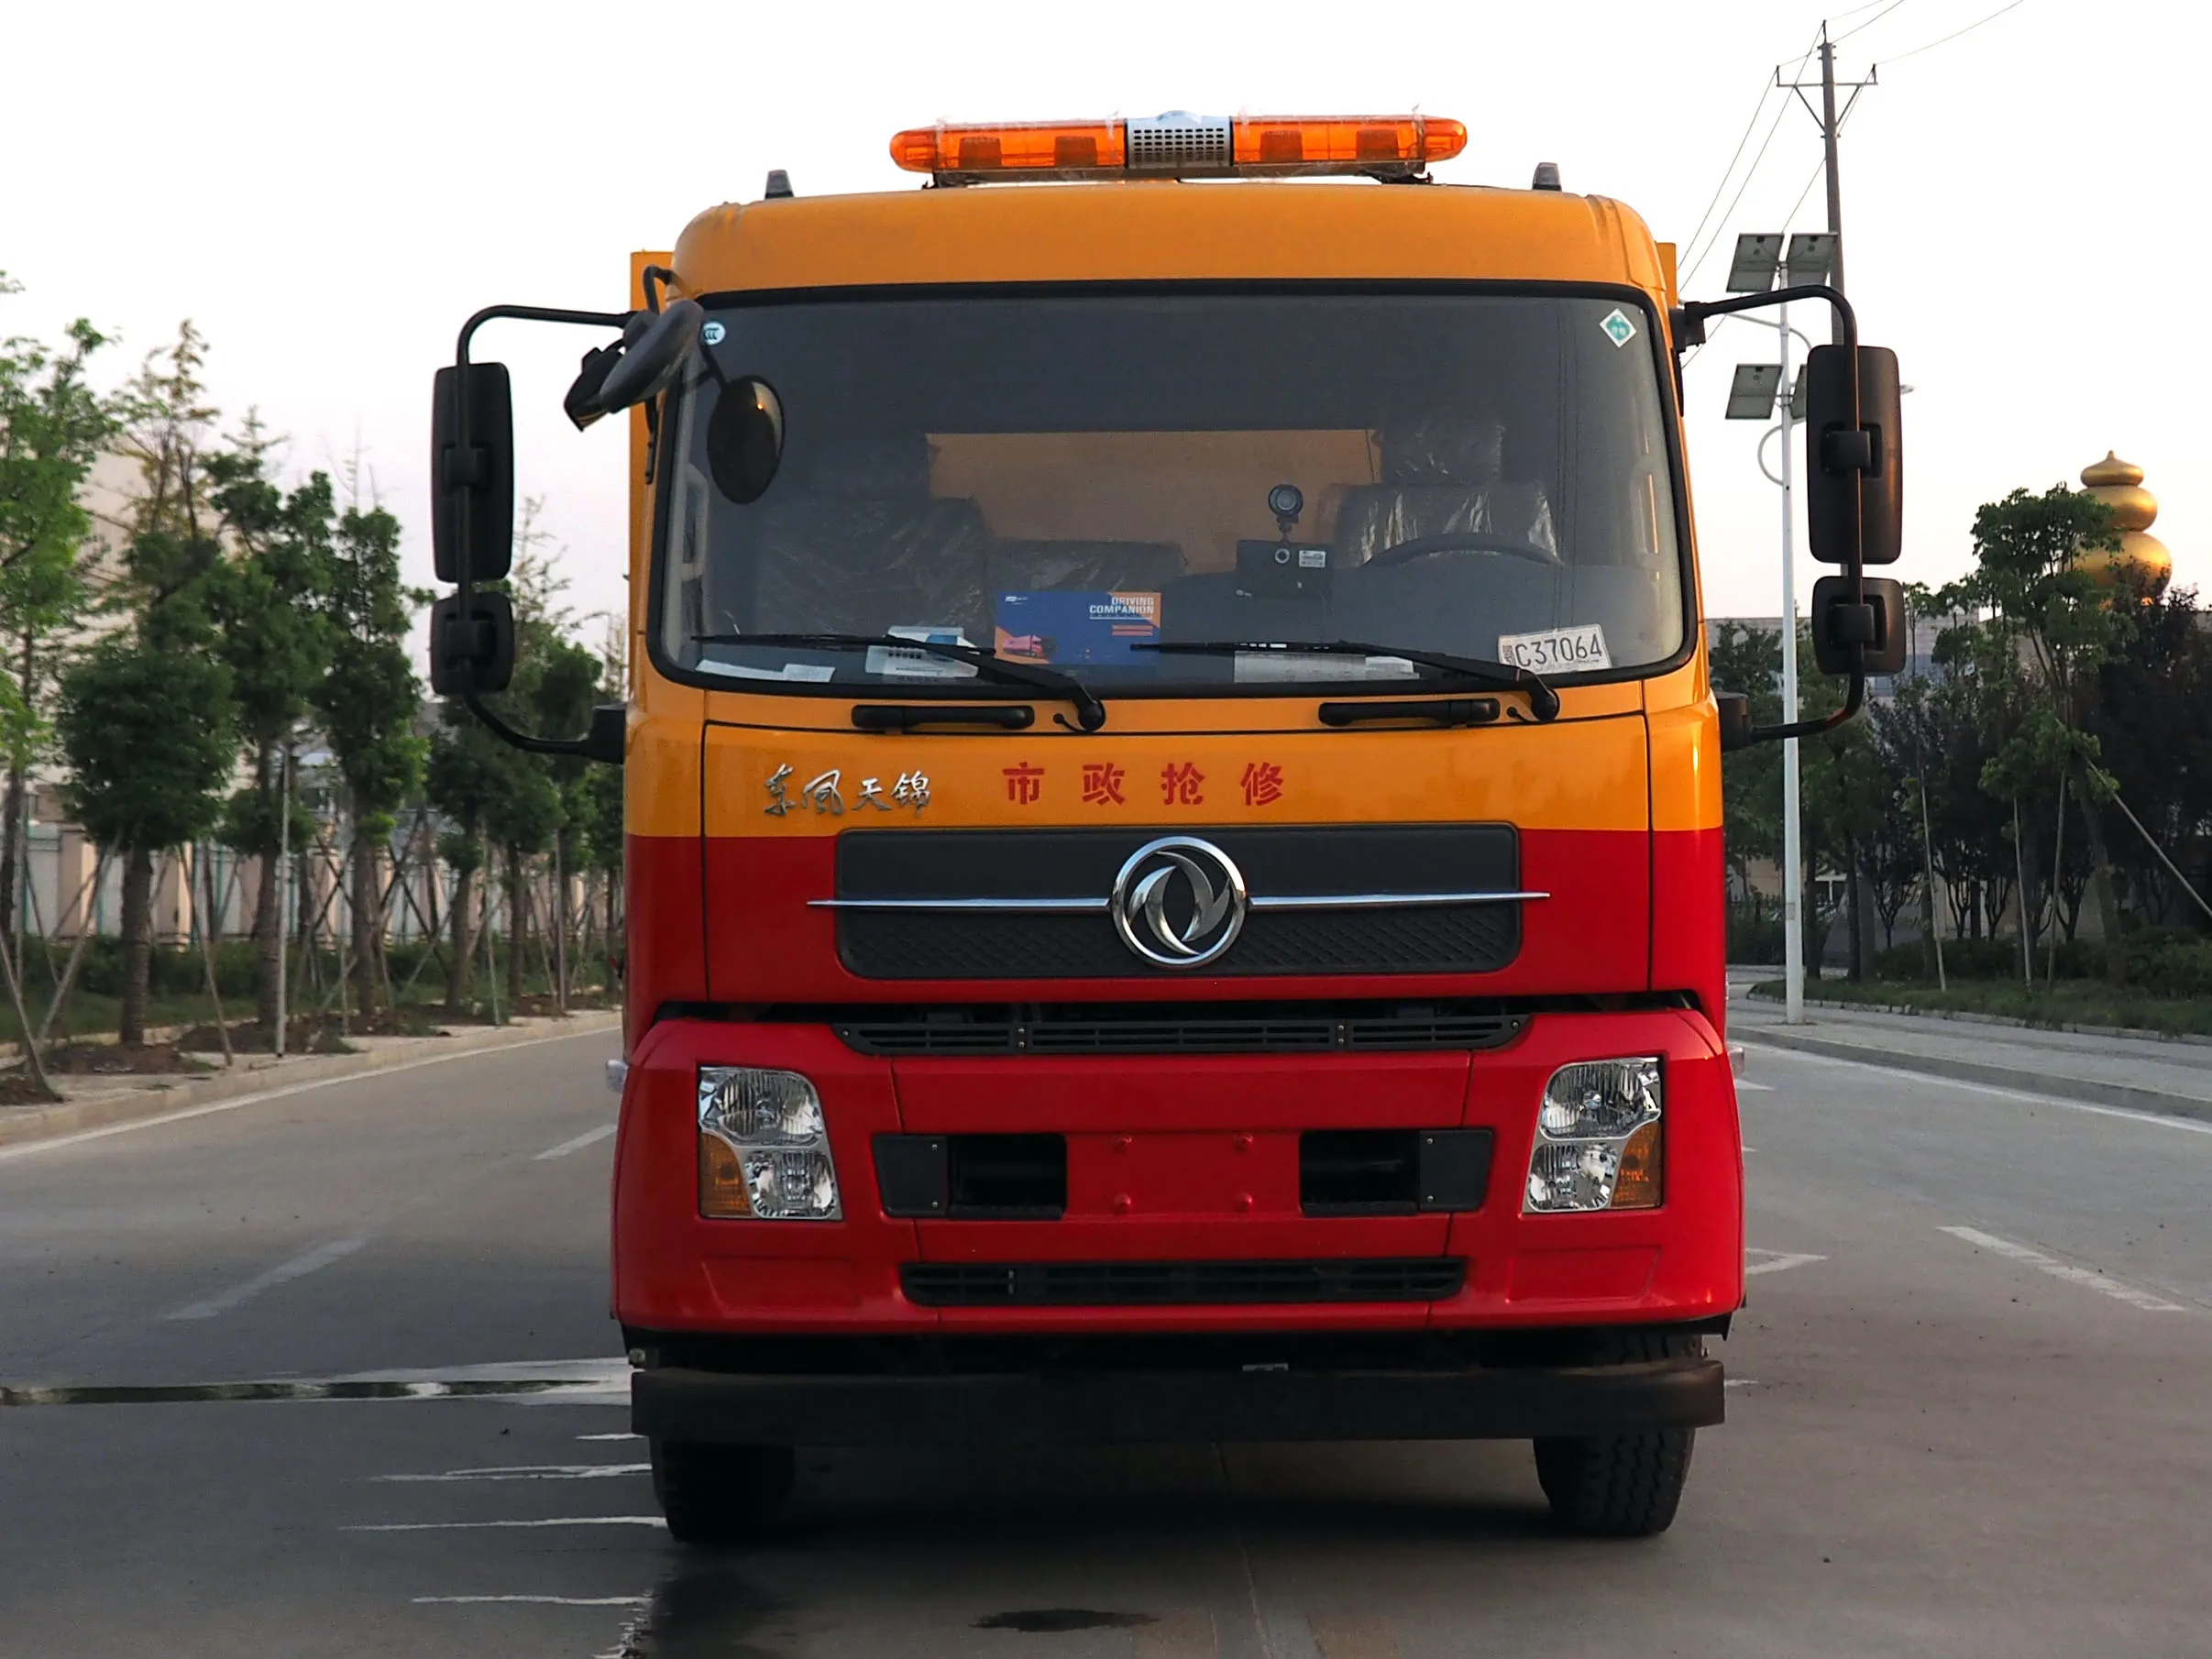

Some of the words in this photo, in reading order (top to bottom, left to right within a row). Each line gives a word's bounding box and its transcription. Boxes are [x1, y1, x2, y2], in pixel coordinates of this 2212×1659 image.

[1089, 605, 1154, 614] COMPANION
[1111, 597, 1154, 605] DRIVING
[1515, 633, 1602, 667] C37064
[1002, 762, 1284, 806] 市政抢修
